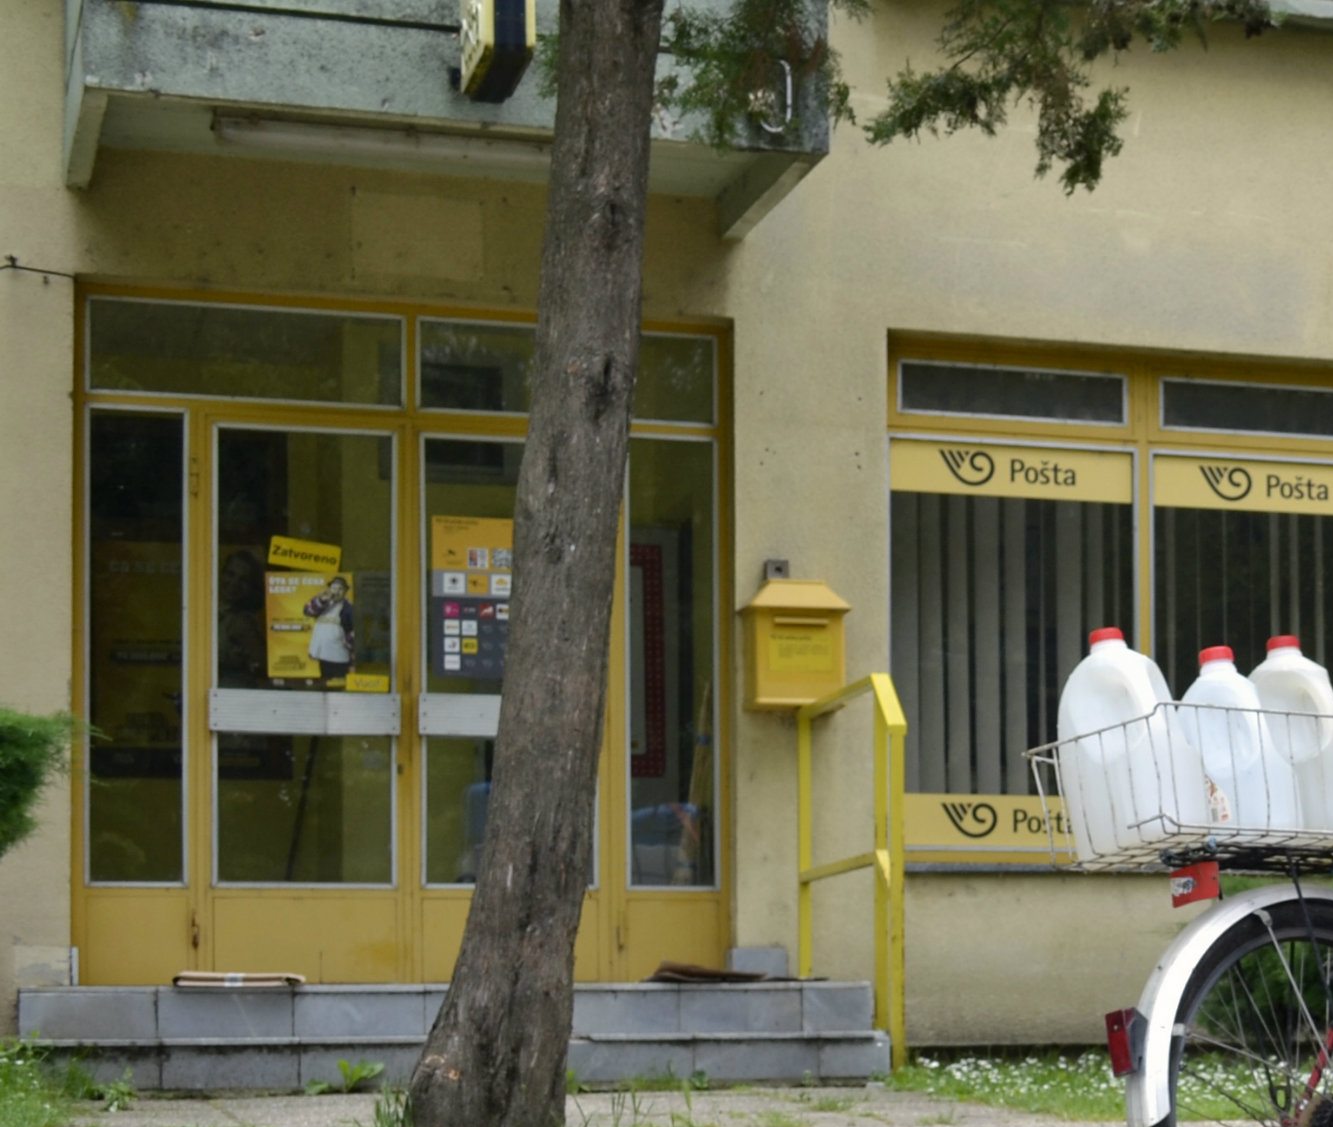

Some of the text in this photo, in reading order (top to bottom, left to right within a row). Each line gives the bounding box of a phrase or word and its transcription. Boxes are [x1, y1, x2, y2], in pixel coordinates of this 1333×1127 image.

[1010, 458, 1076, 486] Pošta
[1266, 474, 1329, 501] Pošta
[271, 544, 338, 566] Zatvoreno
